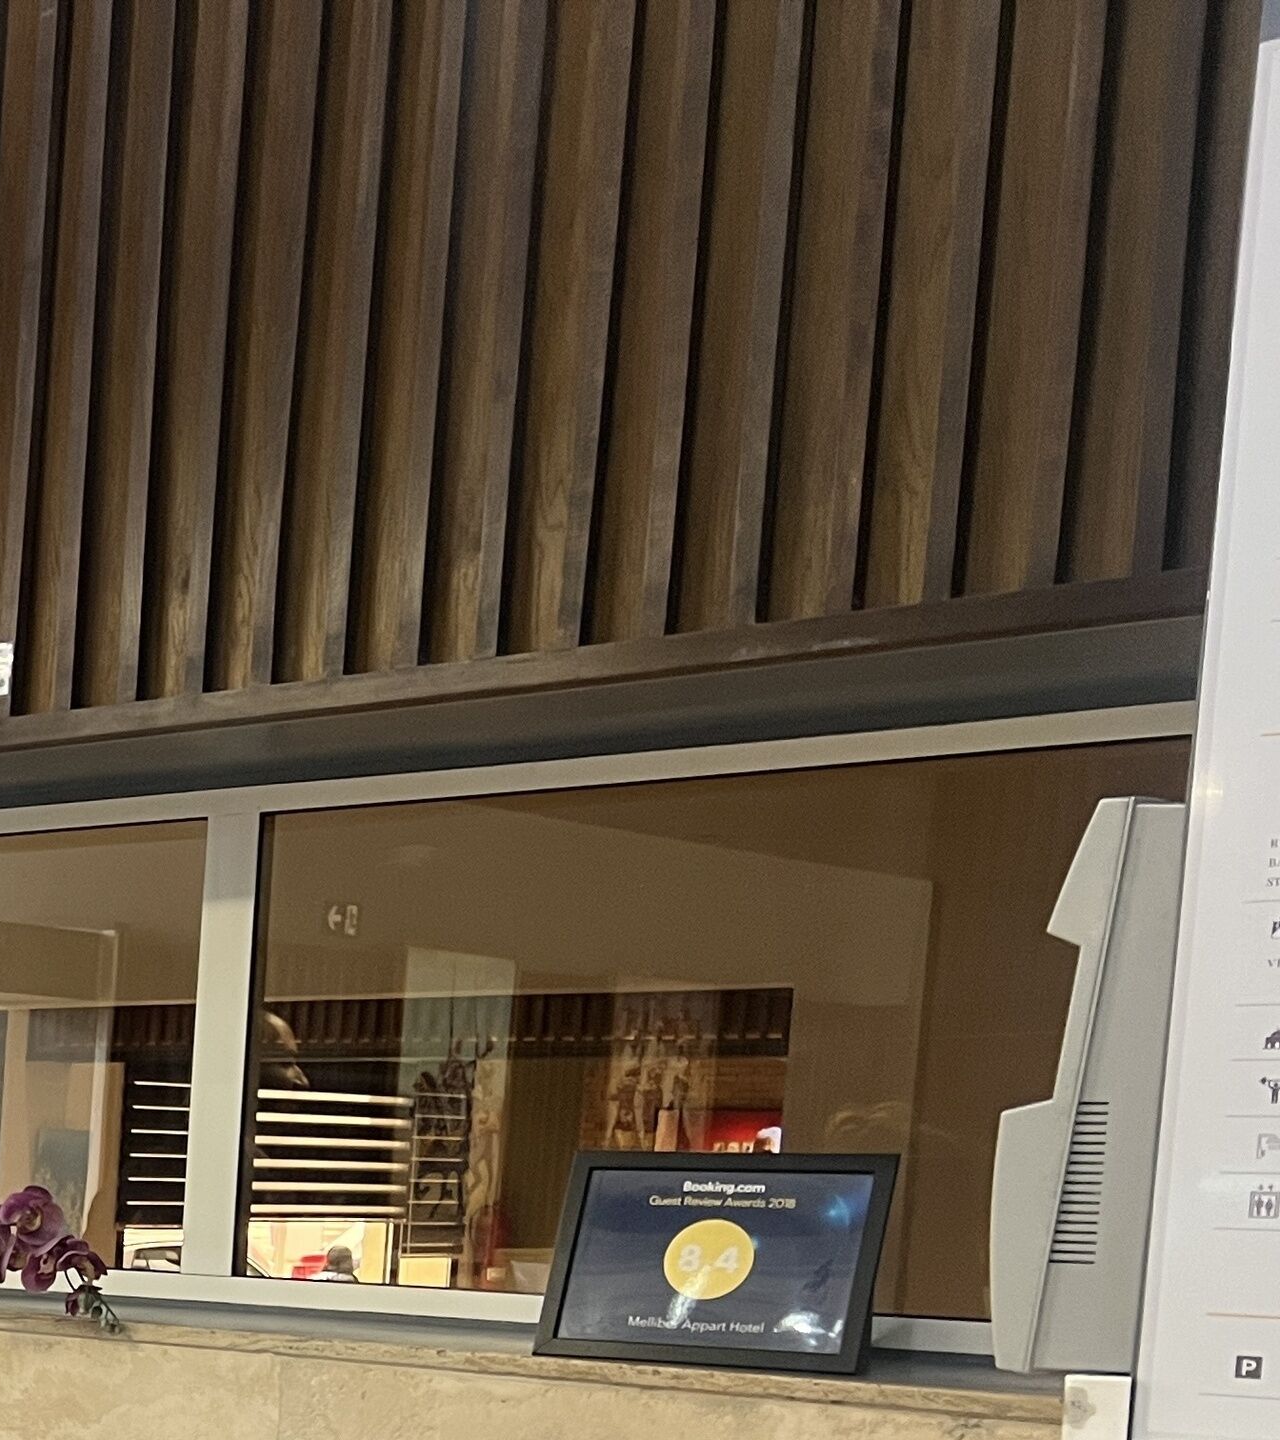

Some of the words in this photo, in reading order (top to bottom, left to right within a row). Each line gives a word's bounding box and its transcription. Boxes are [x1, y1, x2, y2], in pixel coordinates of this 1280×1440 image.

[683, 1180, 767, 1195] Booking.com
[649, 1195, 682, 1207] Guest
[683, 1195, 724, 1208] Review
[722, 1197, 766, 1209] Awards
[681, 1317, 726, 1334] Appart
[728, 1320, 766, 1334] Hotel
